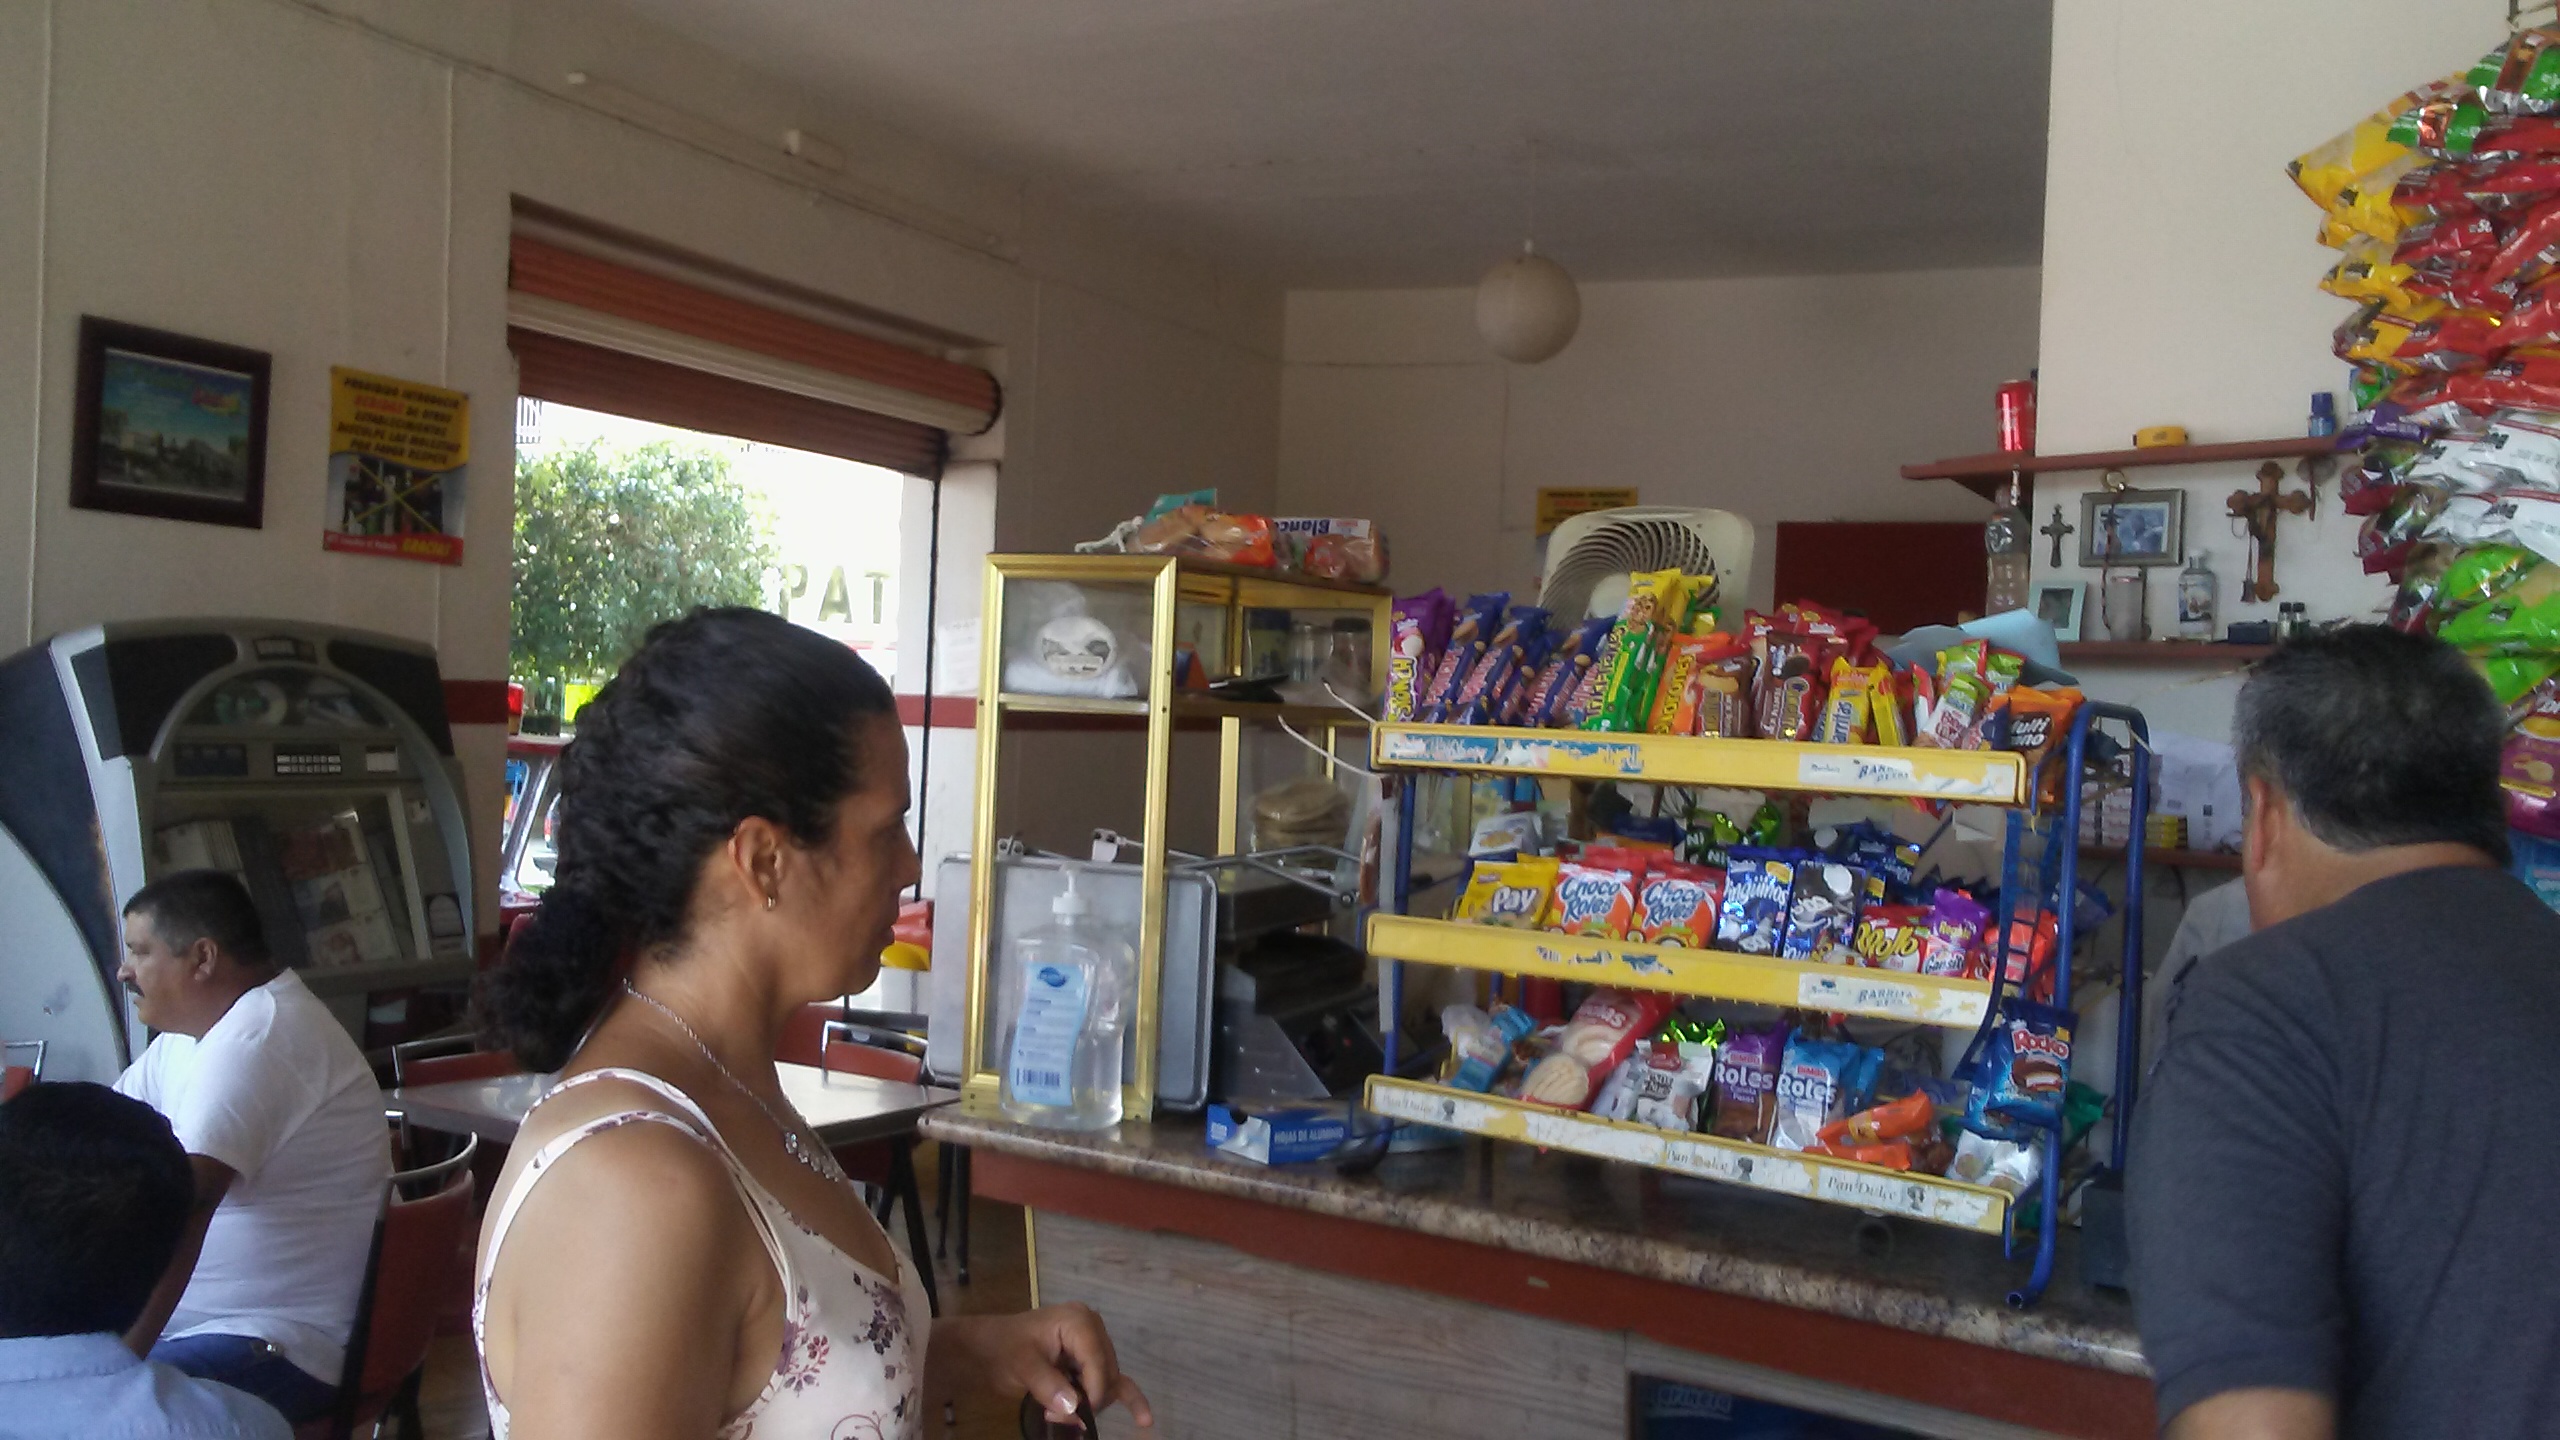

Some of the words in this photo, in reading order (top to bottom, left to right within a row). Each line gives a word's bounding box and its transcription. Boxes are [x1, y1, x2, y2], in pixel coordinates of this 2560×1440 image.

[1831, 700, 1852, 744] arritas
[1491, 885, 1539, 914] Pay
[1558, 877, 1622, 901] Choco
[1641, 880, 1706, 905] Choco
[1725, 873, 1789, 907] ingüinos
[1562, 895, 1613, 925] Roles
[1644, 900, 1695, 927] Roles
[1925, 952, 1966, 974] Gansit
[1714, 1062, 1774, 1090] Roles
[1777, 1073, 1837, 1104] Roles
